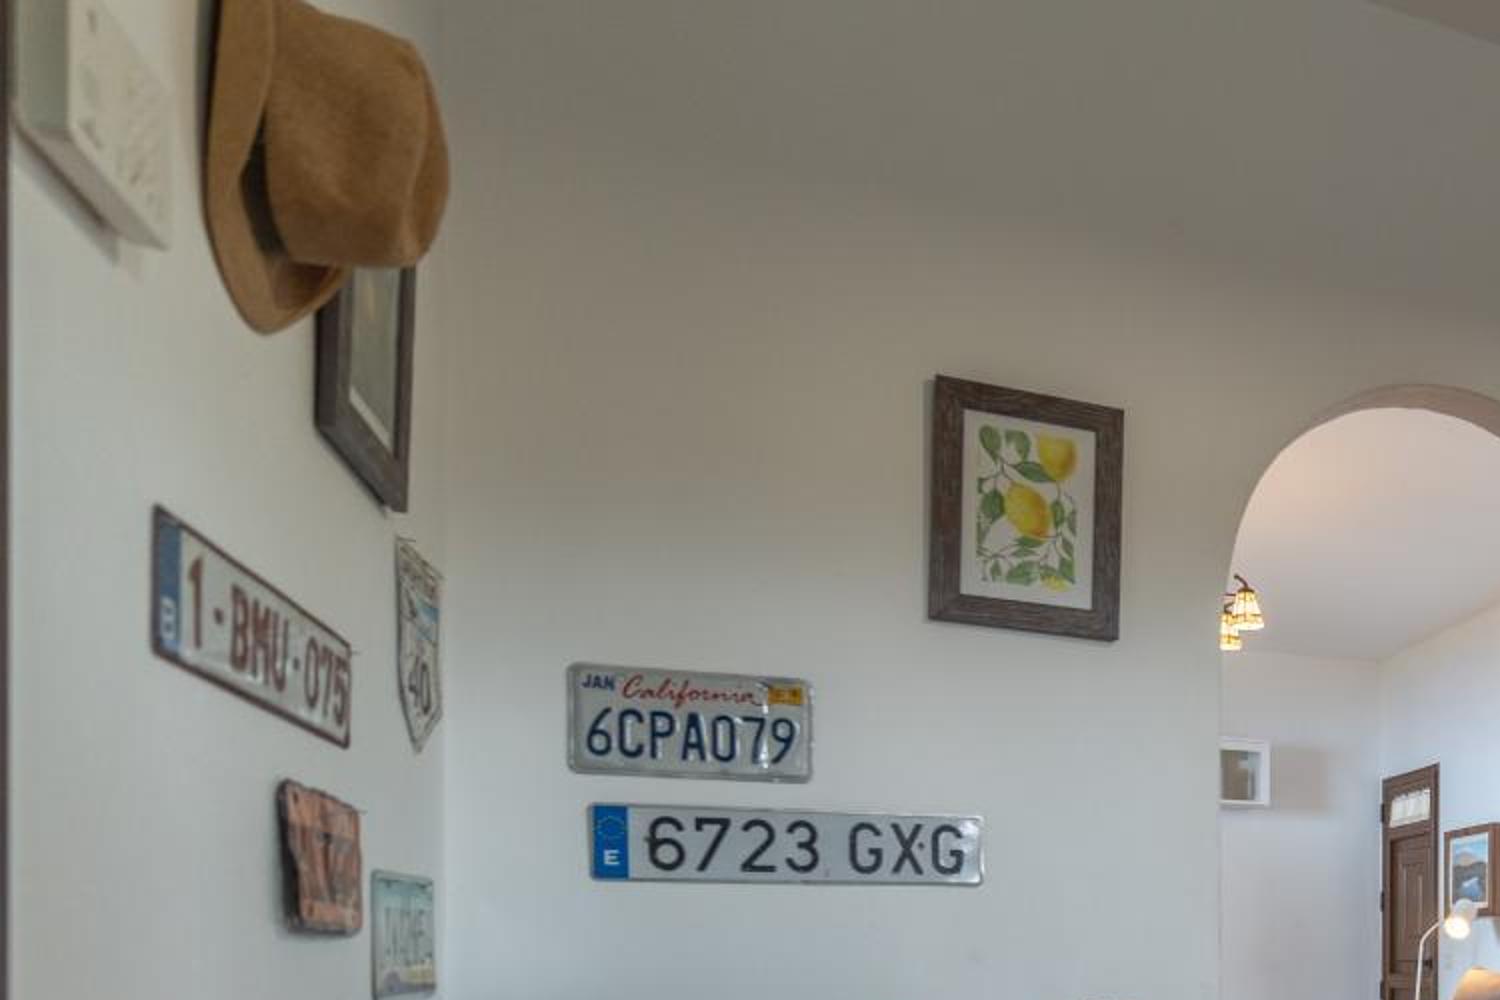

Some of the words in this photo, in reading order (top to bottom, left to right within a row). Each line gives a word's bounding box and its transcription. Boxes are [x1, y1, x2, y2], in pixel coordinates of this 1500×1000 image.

[582, 674, 616, 691] JAN
[620, 675, 763, 709] California
[586, 707, 797, 764] 6CPA079
[603, 849, 620, 866] E
[646, 816, 819, 873] 6723
[848, 822, 965, 875] GXG
